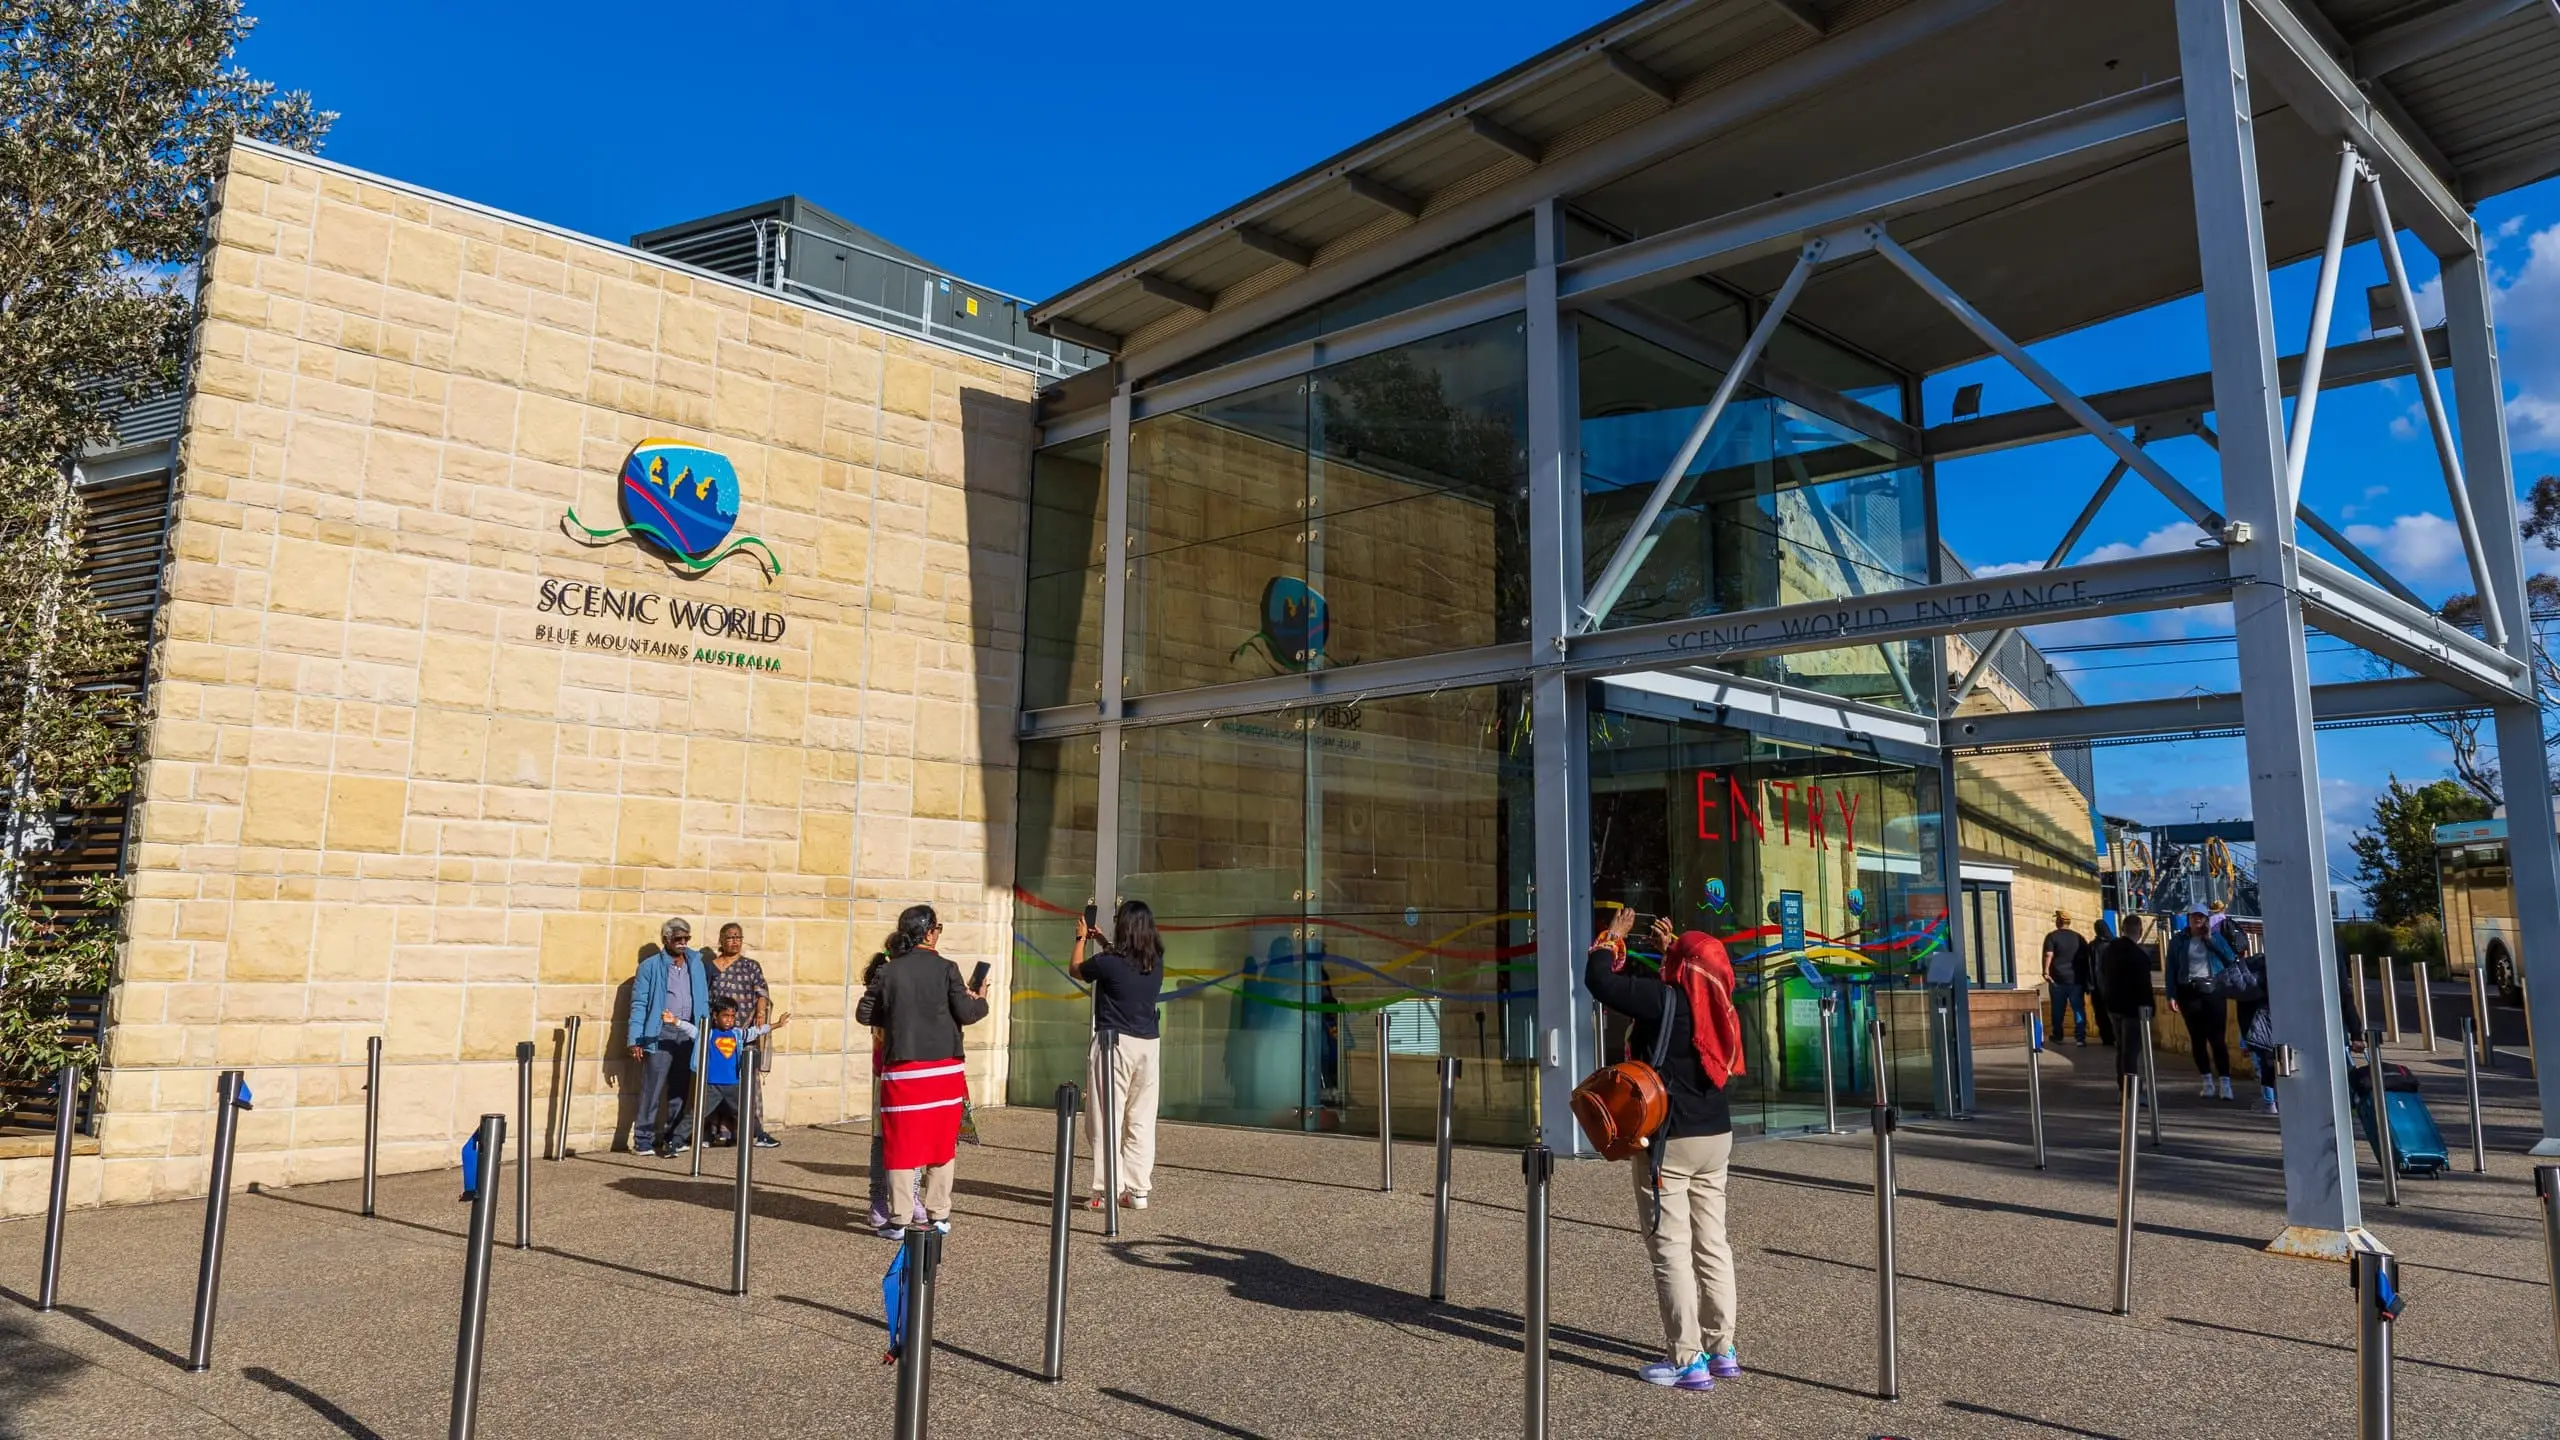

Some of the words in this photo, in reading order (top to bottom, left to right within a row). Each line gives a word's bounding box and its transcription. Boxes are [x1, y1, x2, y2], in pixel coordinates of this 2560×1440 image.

[538, 579, 661, 624] SCENIC
[669, 598, 786, 642] WORLD
[1667, 624, 1759, 650] SCENIC
[1781, 607, 1889, 636] WORLD
[1916, 580, 2087, 618] ENTRANCE
[536, 624, 579, 645] BLUE
[586, 632, 689, 659] MOUNTAINS
[693, 647, 781, 672] AUSTRALIA
[1697, 771, 1860, 852] ENTRY
